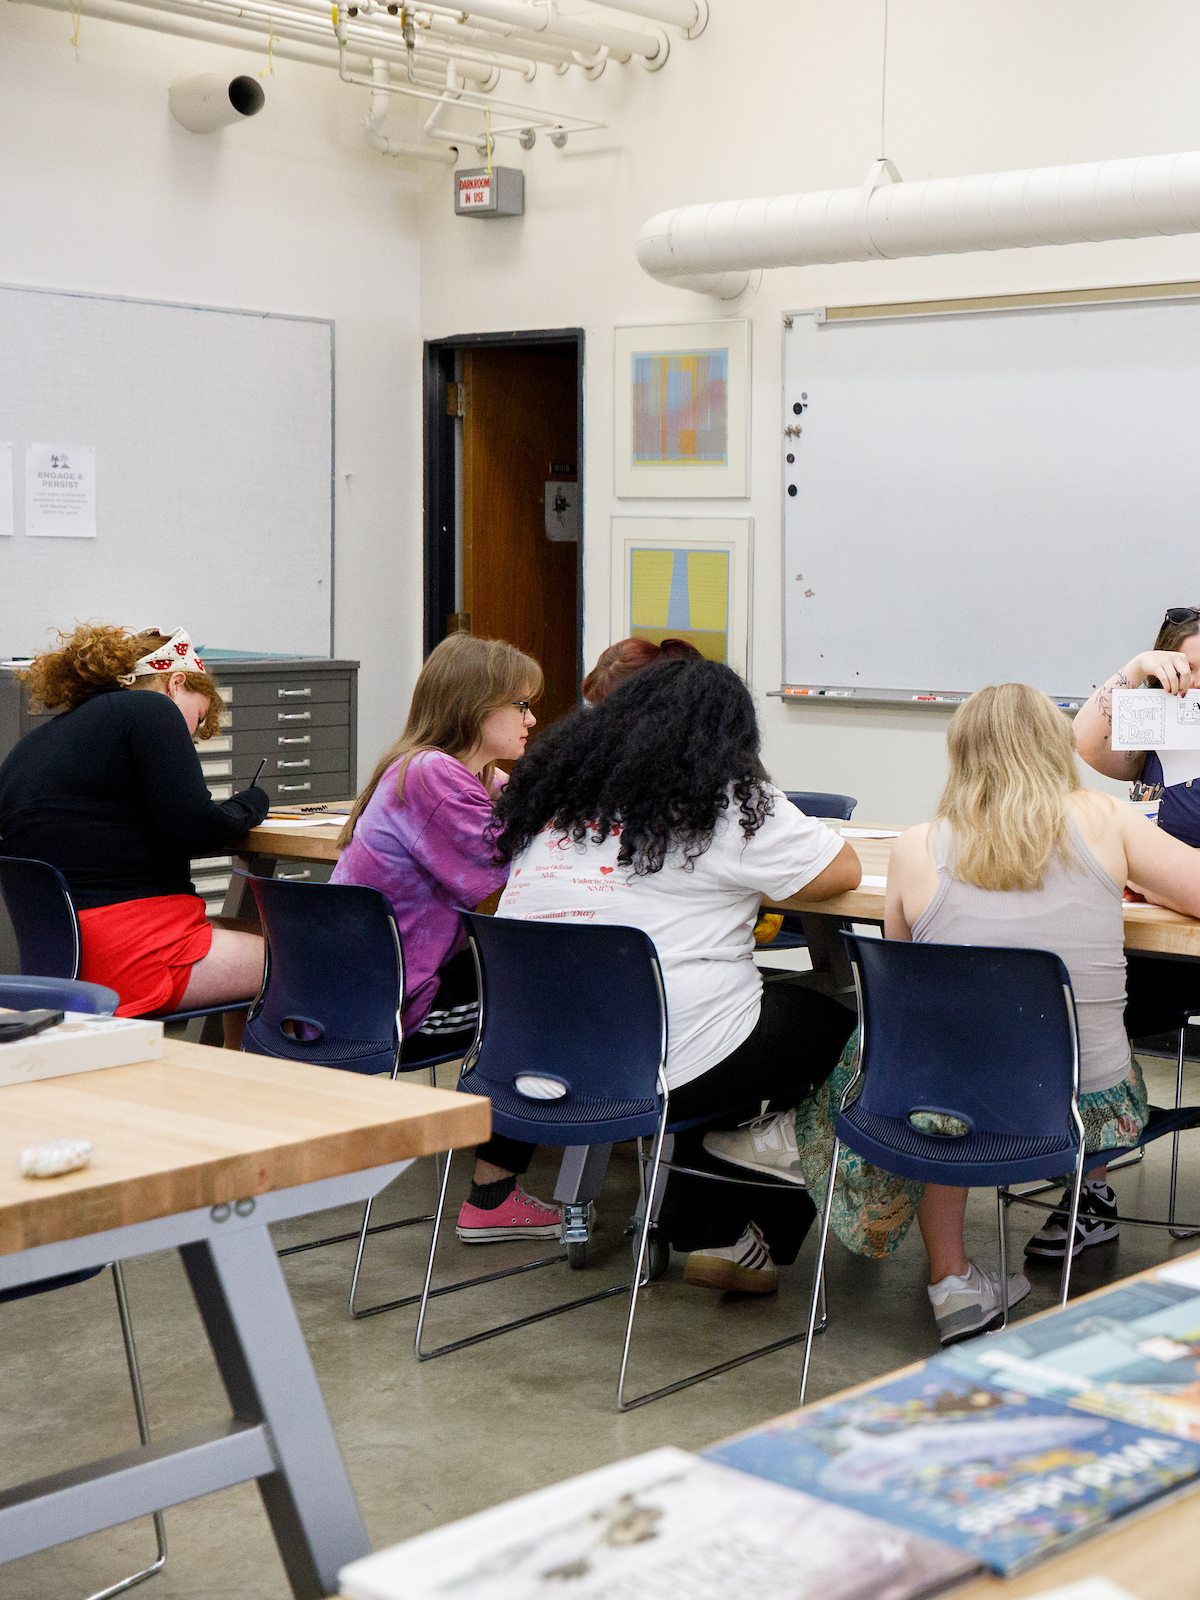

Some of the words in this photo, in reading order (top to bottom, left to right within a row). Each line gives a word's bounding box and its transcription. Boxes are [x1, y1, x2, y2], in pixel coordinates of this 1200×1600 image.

[459, 178, 490, 190] DARKROOM
[465, 193, 471, 203] IN
[474, 191, 484, 203] USE
[38, 471, 76, 480] ENGAGE
[42, 480, 79, 488] PERSIST
[1120, 702, 1160, 726] Super
[1127, 724, 1154, 742] Dog
[571, 909, 596, 920] Diaz
